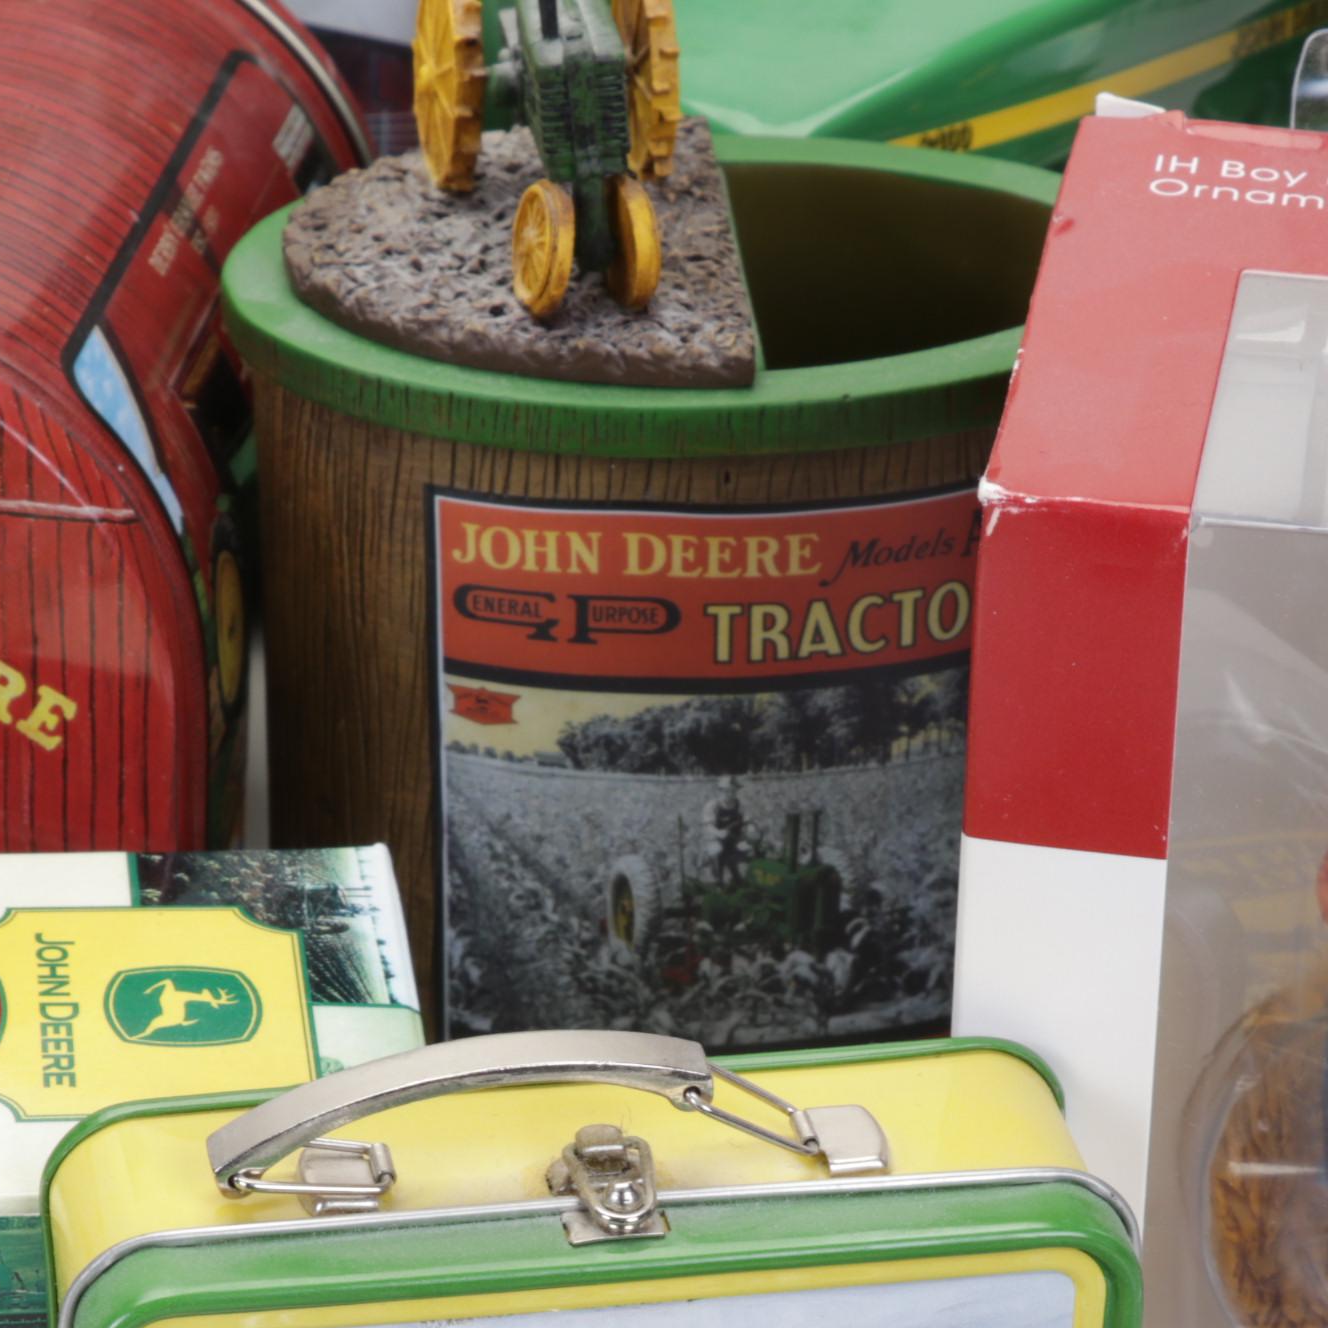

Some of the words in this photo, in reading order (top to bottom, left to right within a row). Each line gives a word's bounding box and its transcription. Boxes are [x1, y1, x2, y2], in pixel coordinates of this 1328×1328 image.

[1153, 154, 1199, 175] IH
[1219, 160, 1308, 188] Boy
[453, 522, 603, 576] JOHN
[622, 532, 823, 579] DEERE
[819, 527, 957, 588] Models
[703, 580, 972, 665] TRACTO
[35, 932, 75, 997] JOHN
[39, 1002, 80, 1088] DEERE
